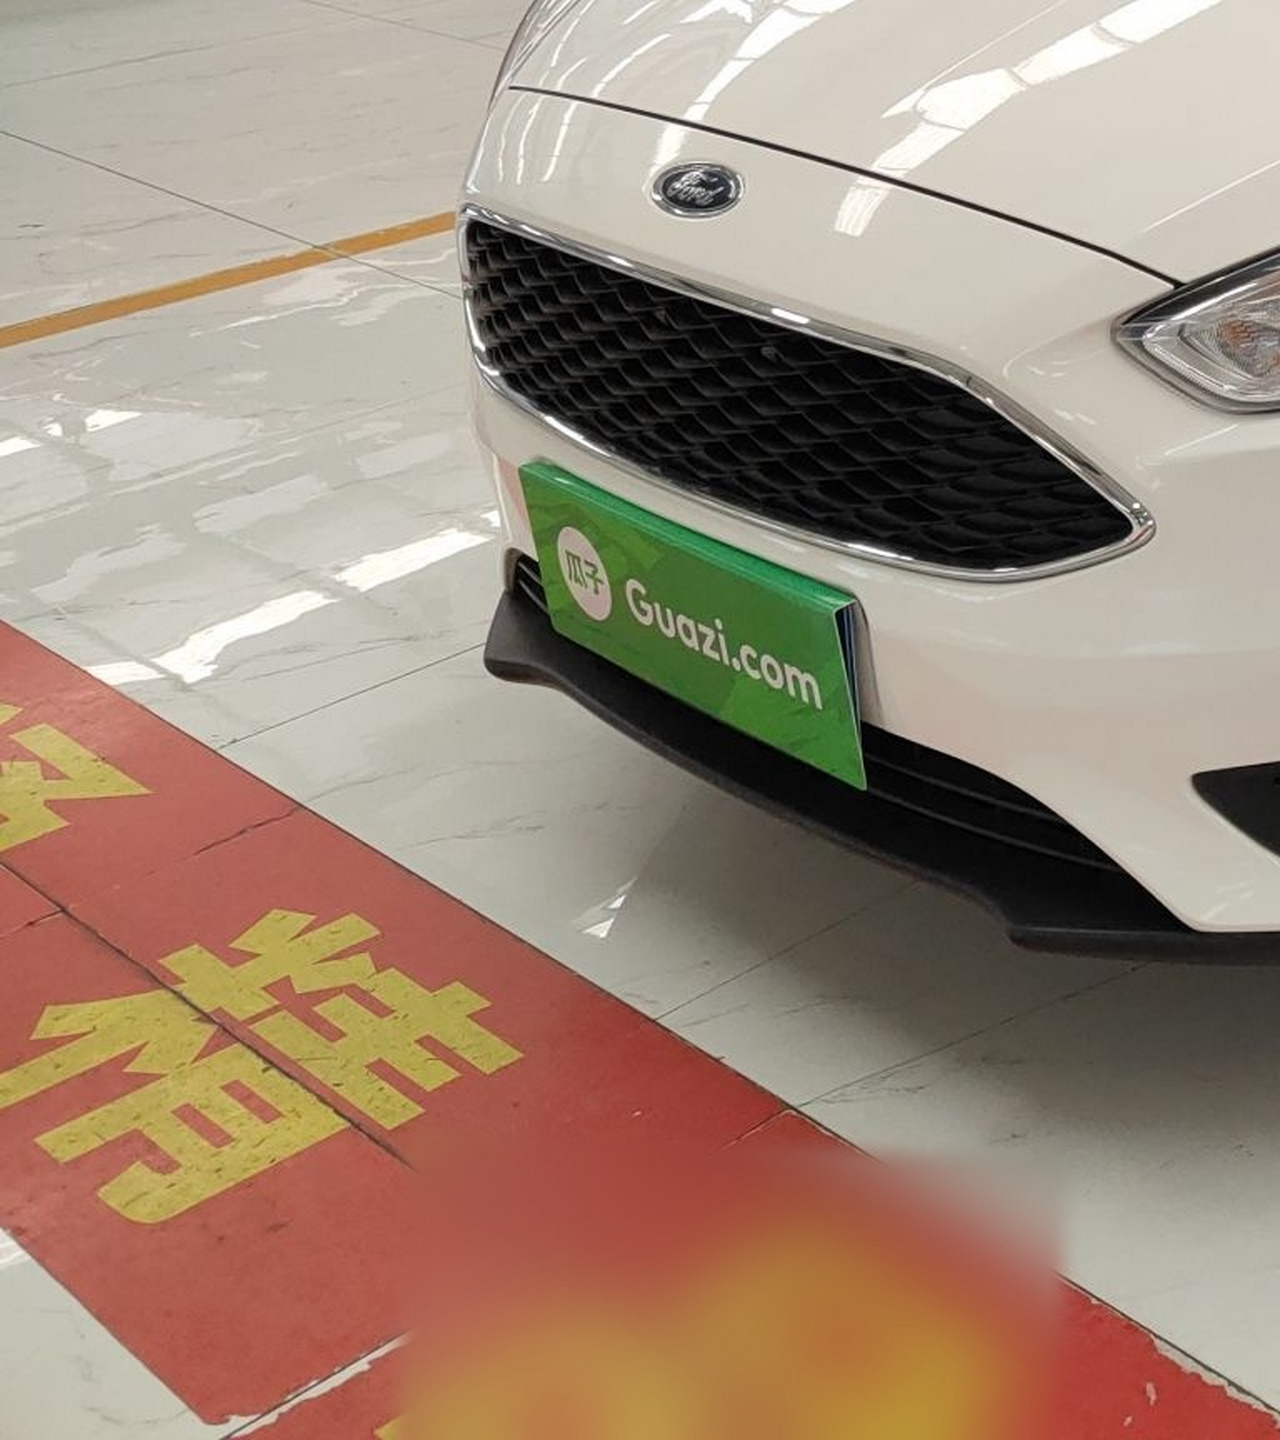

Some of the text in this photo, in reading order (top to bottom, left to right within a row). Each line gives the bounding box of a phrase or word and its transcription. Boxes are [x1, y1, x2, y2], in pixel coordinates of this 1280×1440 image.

[666, 170, 725, 206] Ford
[565, 549, 605, 596] 瓜子
[625, 577, 823, 711] Guazi.com
